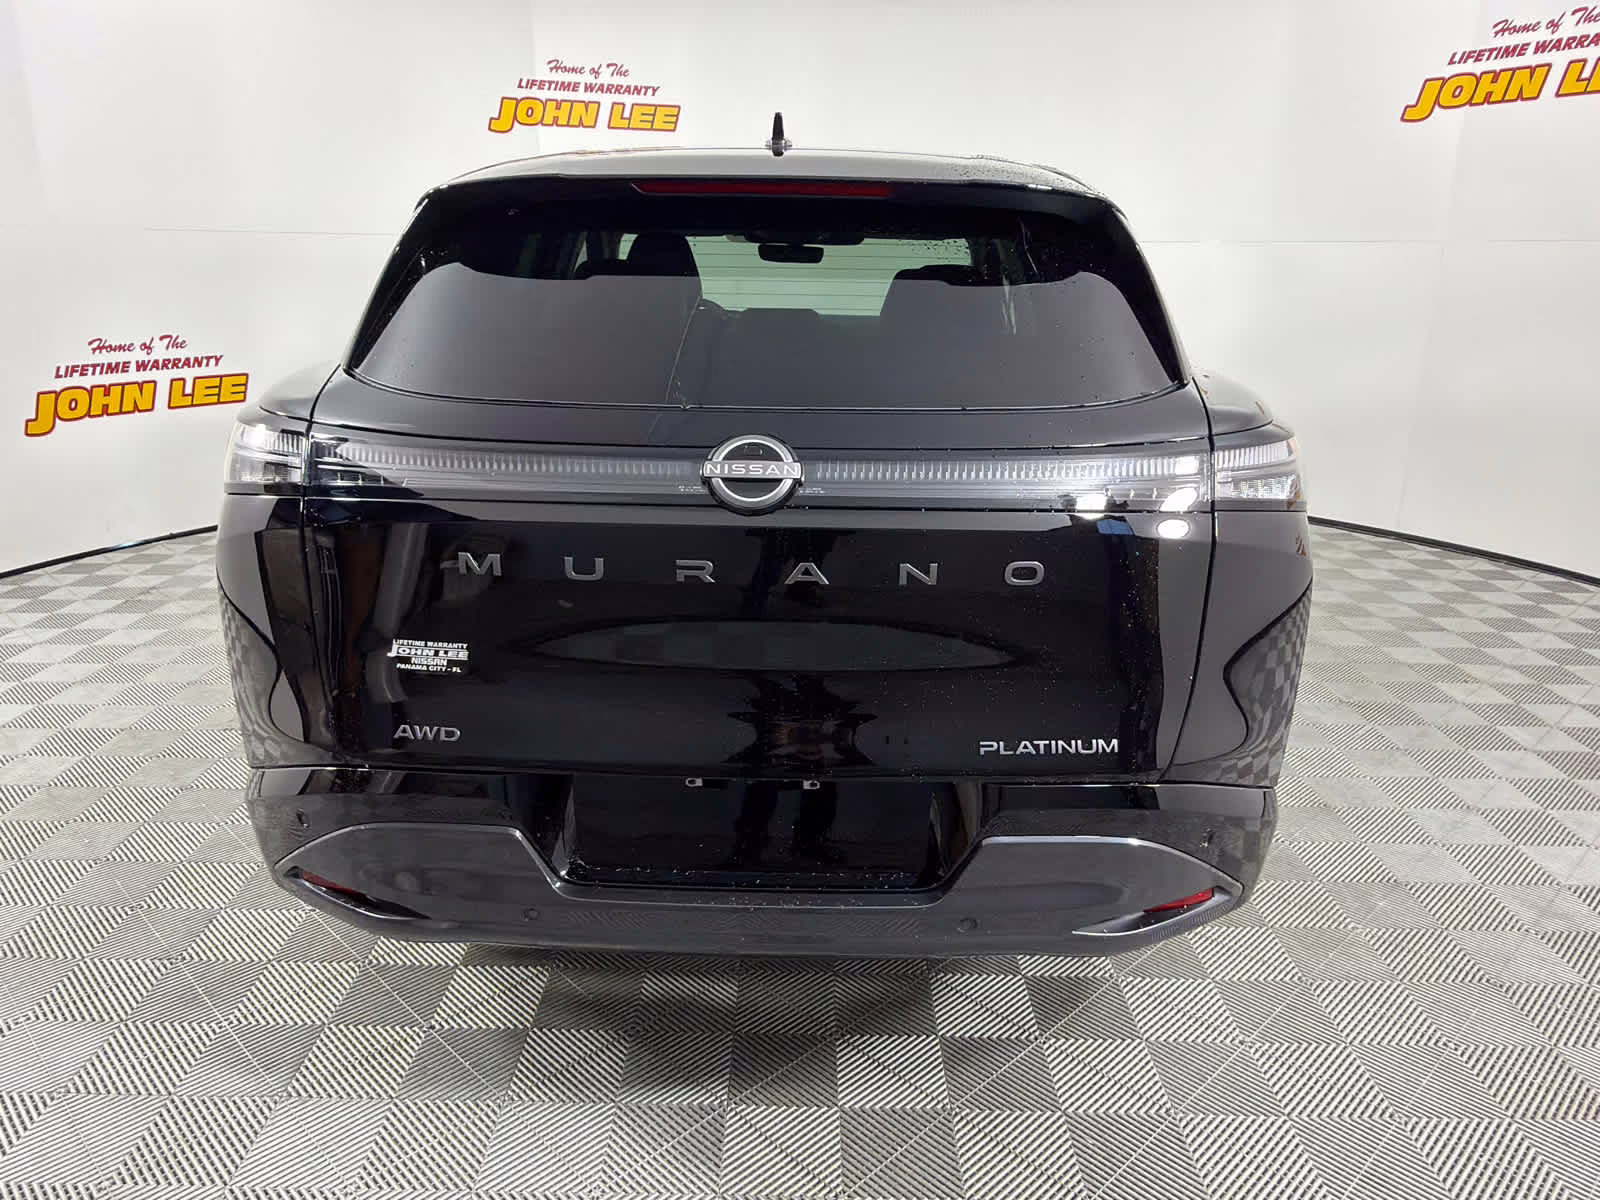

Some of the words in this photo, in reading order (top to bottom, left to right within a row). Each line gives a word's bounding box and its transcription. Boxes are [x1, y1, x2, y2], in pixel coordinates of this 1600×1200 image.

[1492, 19, 1541, 38] Home
[1545, 11, 1566, 35] of
[1570, 6, 1600, 26] The
[1448, 41, 1532, 65] LIFETIME
[547, 59, 585, 76] Home
[589, 64, 602, 79] of
[606, 63, 630, 77] The
[517, 78, 580, 93] LIFETIME
[584, 82, 661, 97] WARRANTY
[1400, 62, 1552, 122] JOHN
[488, 97, 600, 133] JOHN
[608, 102, 681, 132] LEE
[88, 338, 135, 355] Home
[140, 337, 154, 356] of
[159, 334, 188, 350] The
[55, 360, 130, 379] LIFETIME
[135, 354, 224, 373] WARRANTY
[24, 380, 157, 437] JOHN
[168, 373, 249, 409] LEE
[706, 463, 798, 476] NISSAN
[457, 551, 1045, 586] MURANO
[387, 644, 435, 658] JOHN
[438, 649, 469, 658] LEE
[427, 641, 468, 649] WARRANTY
[396, 663, 427, 671] PANAMA
[411, 657, 448, 666] NISSAN
[393, 724, 461, 742] AWD
[979, 738, 1119, 755] PLATINUM
